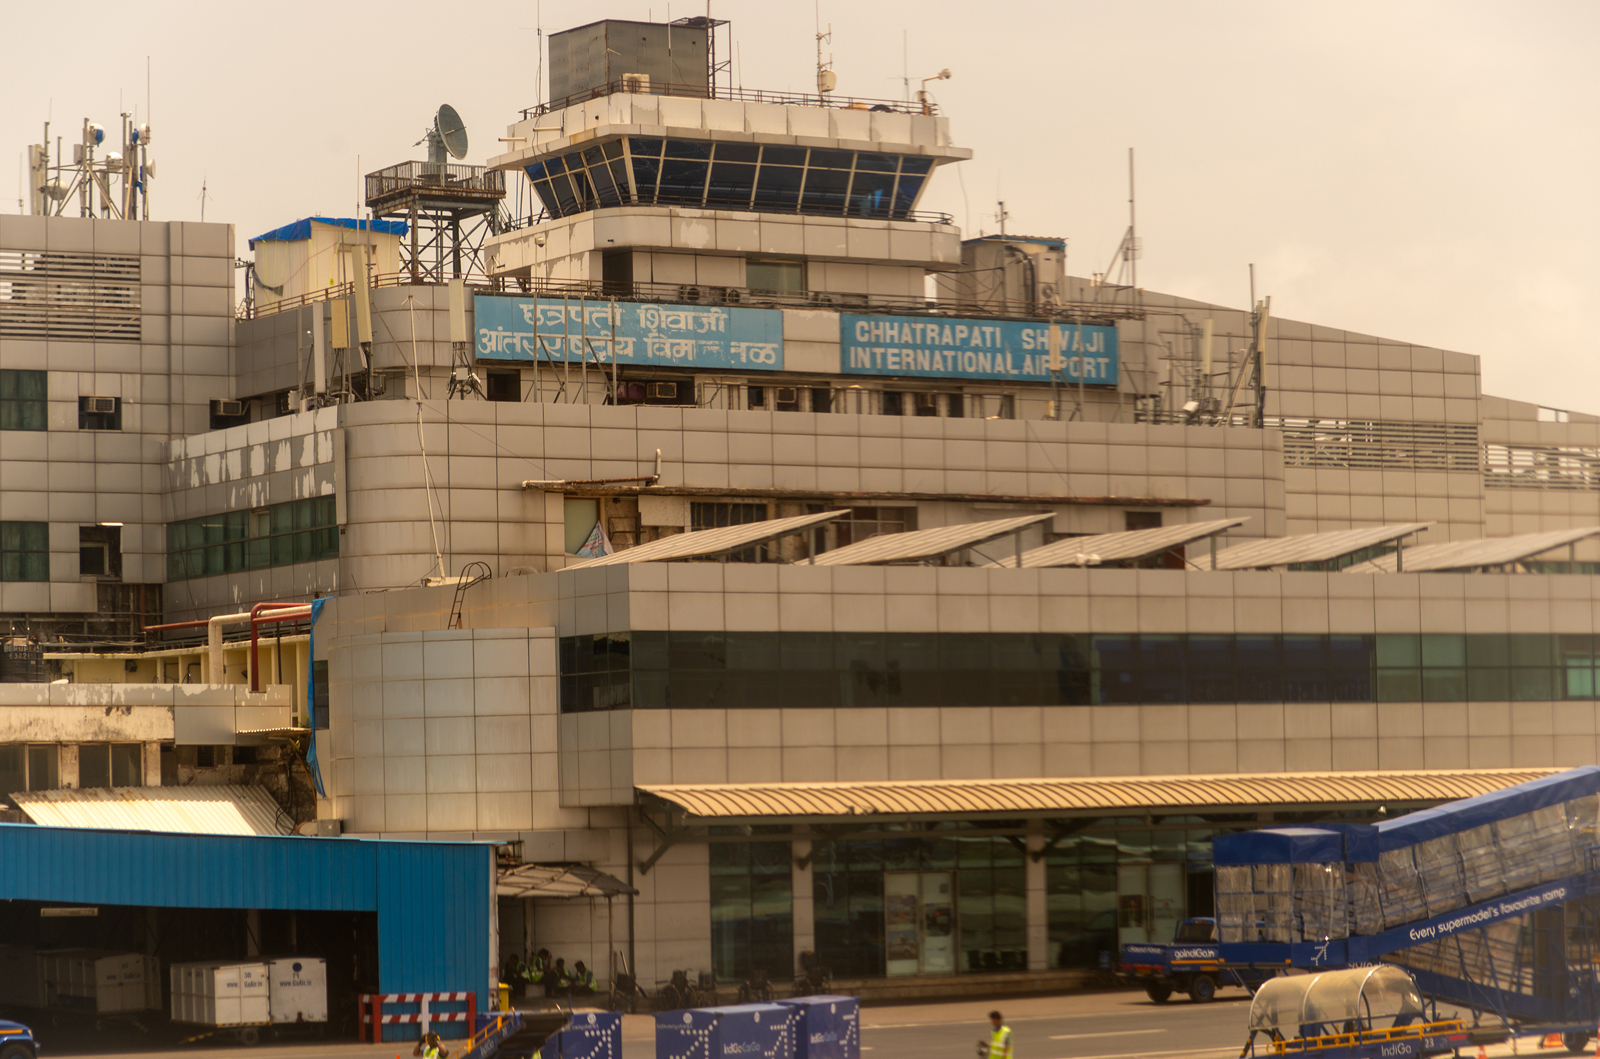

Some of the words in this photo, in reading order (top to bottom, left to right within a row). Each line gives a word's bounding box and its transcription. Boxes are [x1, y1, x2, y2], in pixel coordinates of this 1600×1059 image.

[636, 304, 729, 333] शिवाजी
[855, 320, 1001, 348] CHHATRAPATI
[1021, 328, 1104, 353] SHVAJI
[850, 346, 1019, 375] INTERNATIONAL
[1409, 927, 1436, 940] Every
[1437, 906, 1499, 933] supermodel's
[1500, 895, 1540, 914] favourite
[1542, 887, 1565, 901] ramp
[1174, 948, 1215, 960] goIndiGo.in
[1381, 1042, 1412, 1057] IndiGo
[1424, 1038, 1435, 1048] 23
